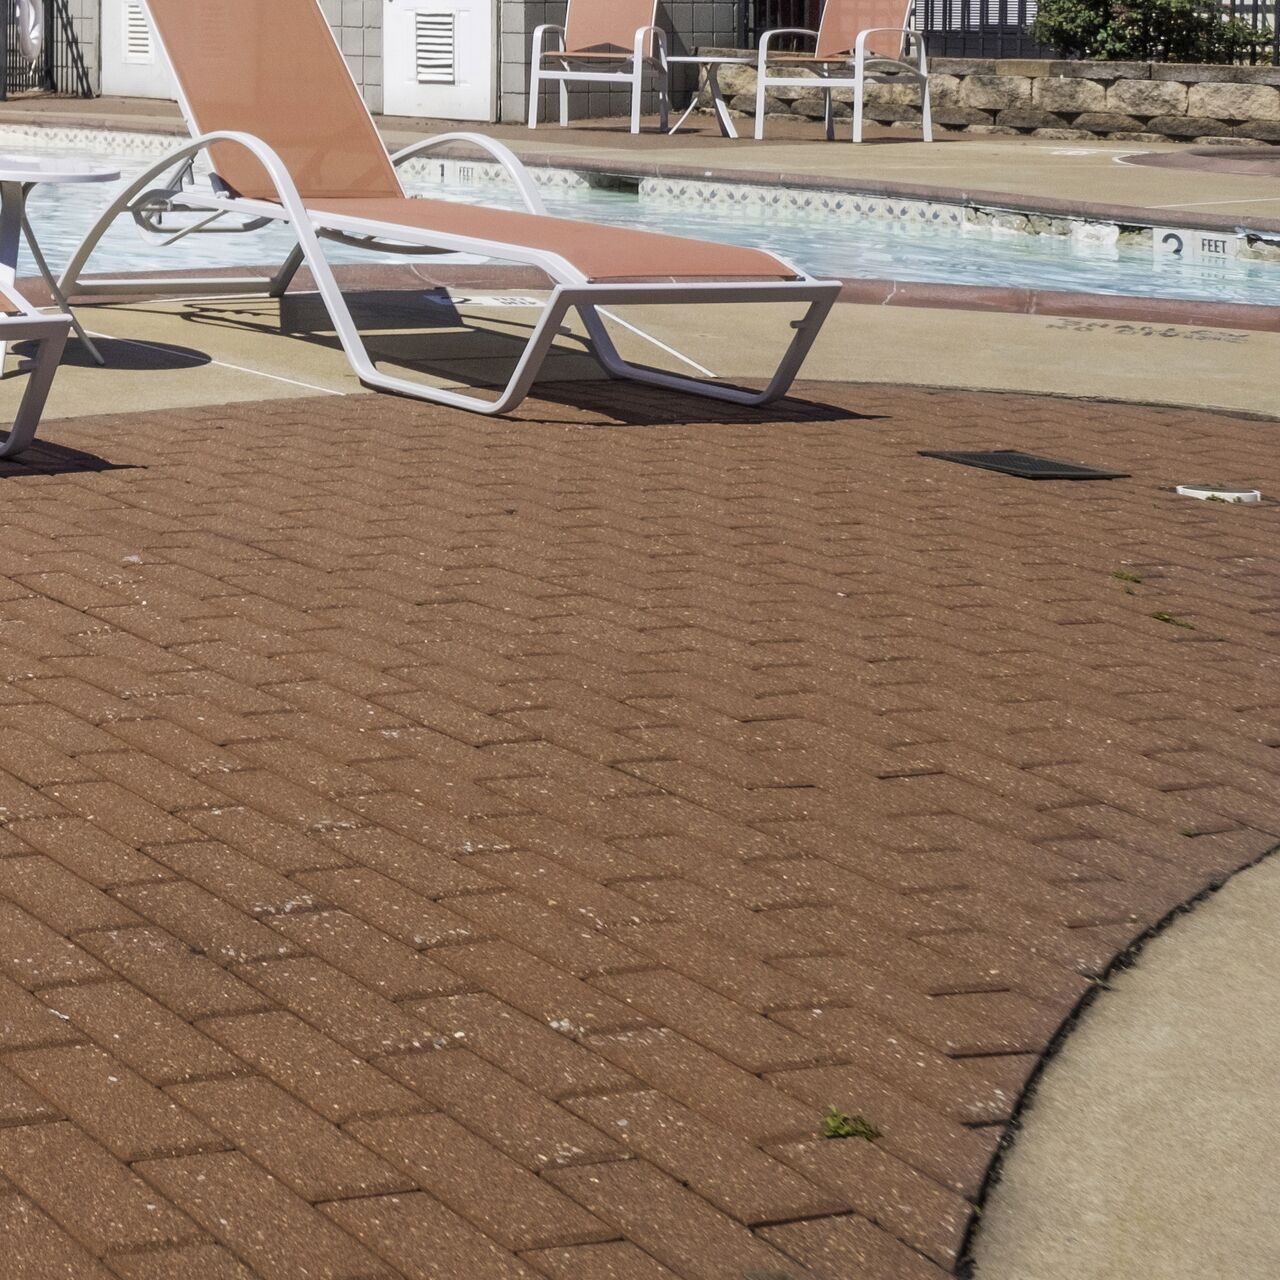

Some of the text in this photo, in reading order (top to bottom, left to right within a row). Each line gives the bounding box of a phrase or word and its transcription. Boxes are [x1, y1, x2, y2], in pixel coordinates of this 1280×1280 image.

[438, 163, 474, 177] 1 FEET
[1201, 238, 1227, 254] FEET
